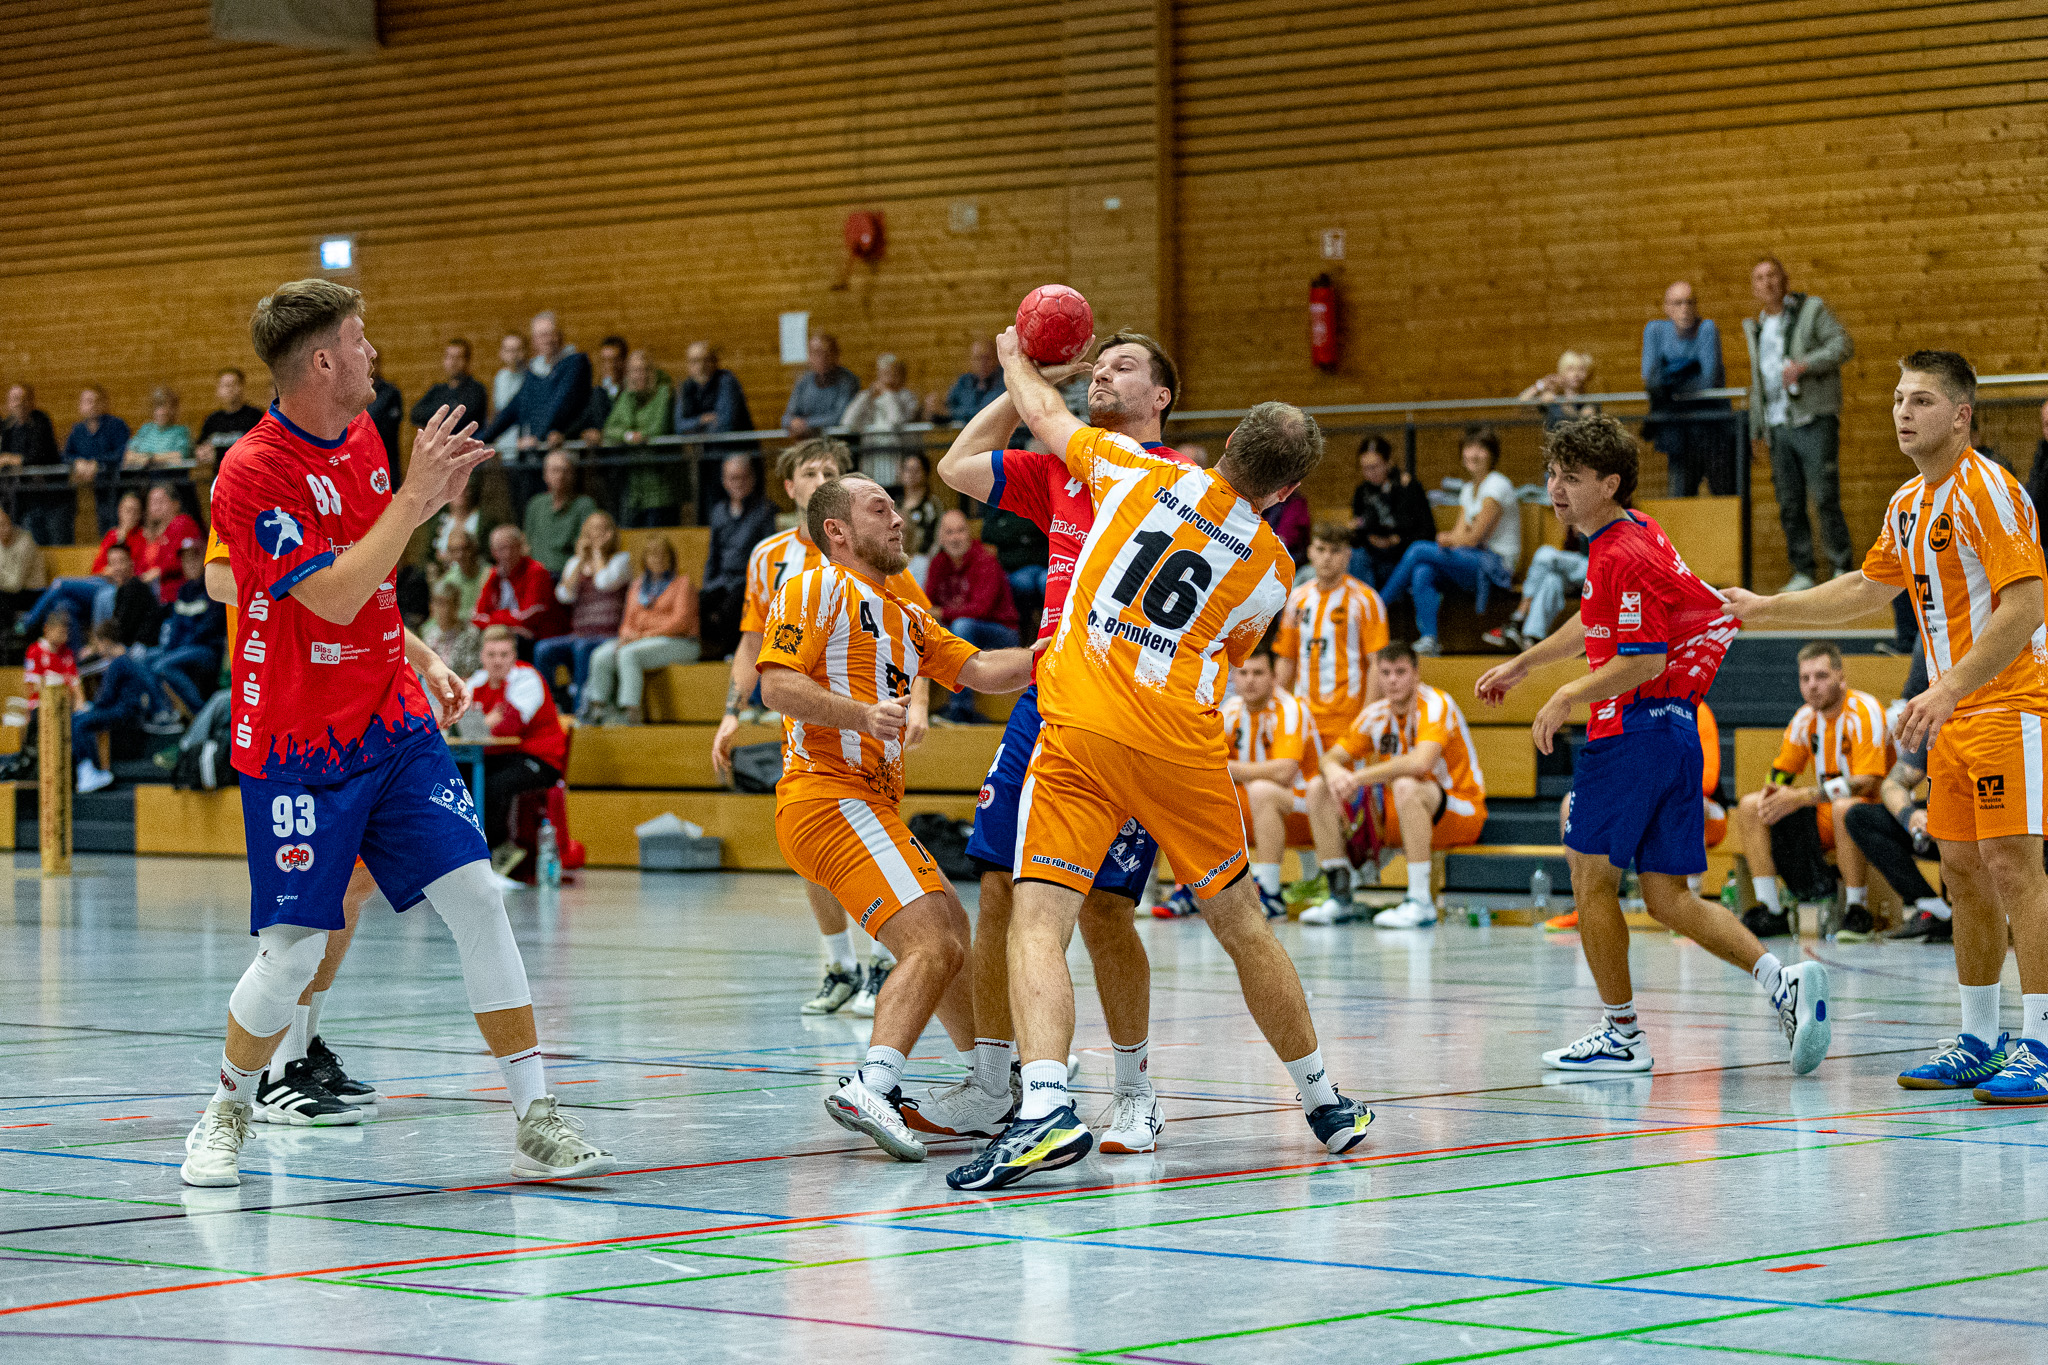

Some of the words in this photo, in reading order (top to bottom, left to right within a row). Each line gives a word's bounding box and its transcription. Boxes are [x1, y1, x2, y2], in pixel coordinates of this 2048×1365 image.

[1152, 486, 1180, 511] TSG
[1176, 503, 1253, 562] Kirchhellen
[773, 561, 789, 591] 7
[1110, 528, 1213, 631] 16
[860, 600, 880, 638] 4
[313, 644, 332, 654] Biss
[319, 653, 338, 662] &Co
[272, 794, 317, 838] 93
[281, 847, 310, 864] HSG
[1031, 854, 1051, 866] ALLES
[1051, 858, 1066, 869] FÜR
[1193, 875, 1211, 888] ALLES
